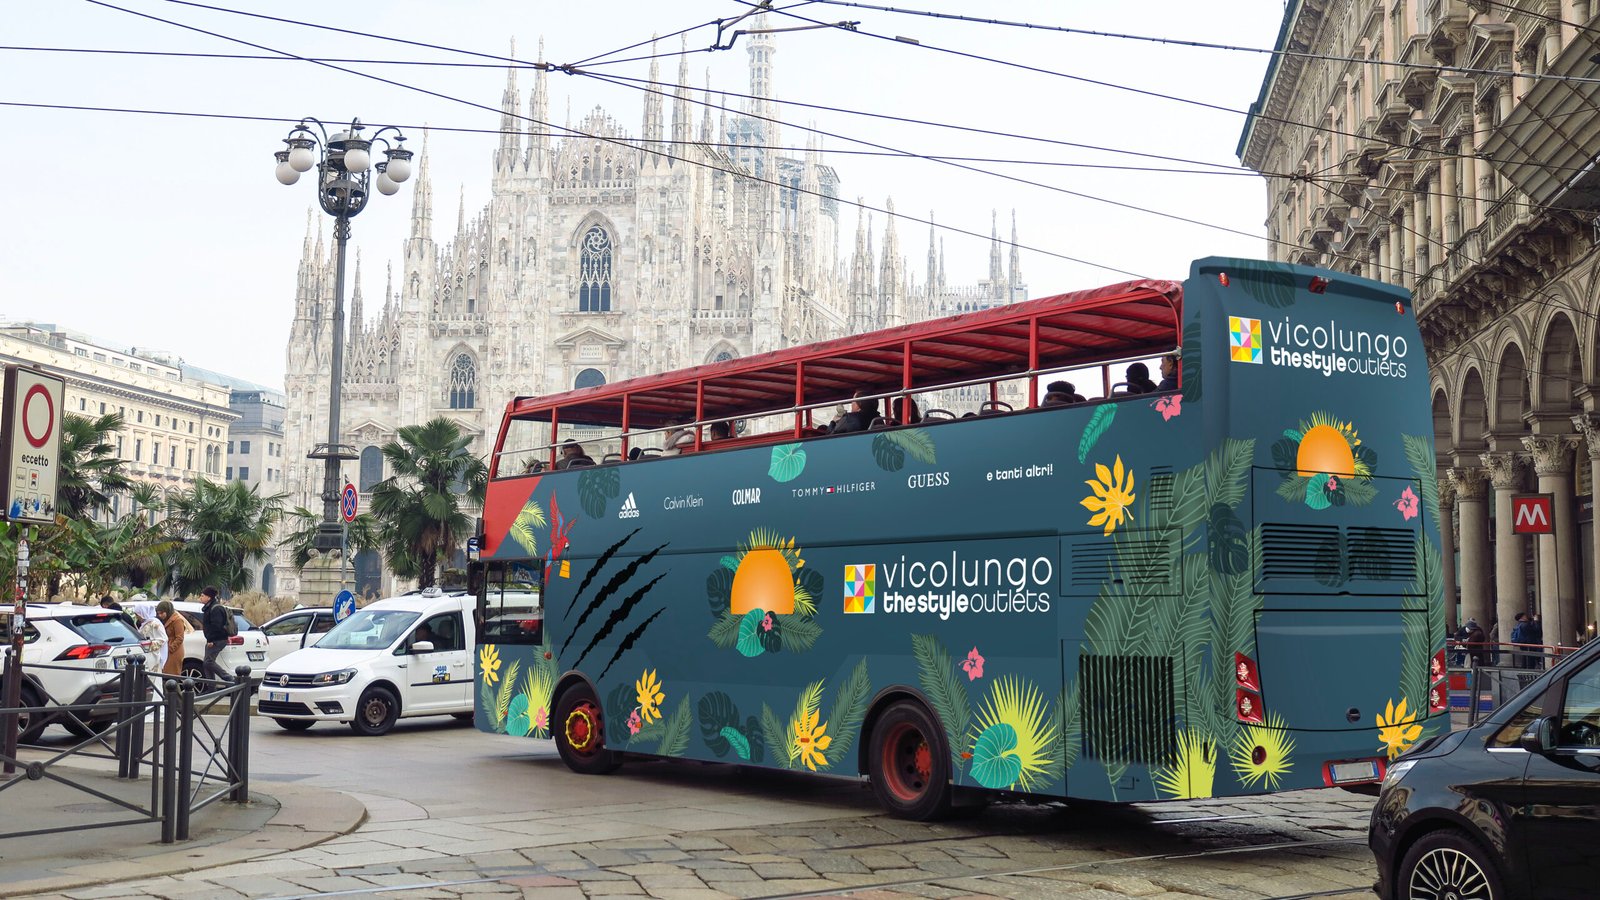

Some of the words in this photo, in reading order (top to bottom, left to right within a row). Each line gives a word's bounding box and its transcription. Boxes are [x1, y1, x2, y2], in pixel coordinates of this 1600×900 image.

[1268, 316, 1408, 360] vicolungo
[22, 454, 49, 467] eccetto
[907, 471, 950, 489] GUESS
[986, 471, 994, 481] e
[995, 466, 1023, 480] tanti
[1025, 463, 1054, 477] altri!
[732, 487, 761, 506] COLMAR
[791, 486, 825, 498] TOMMY
[836, 481, 876, 494] HILFIGER
[663, 495, 685, 510] Calvin
[686, 493, 704, 508] Klein
[618, 504, 640, 519] adidas
[1515, 503, 1548, 526] M
[882, 550, 1053, 593] vicolungo
